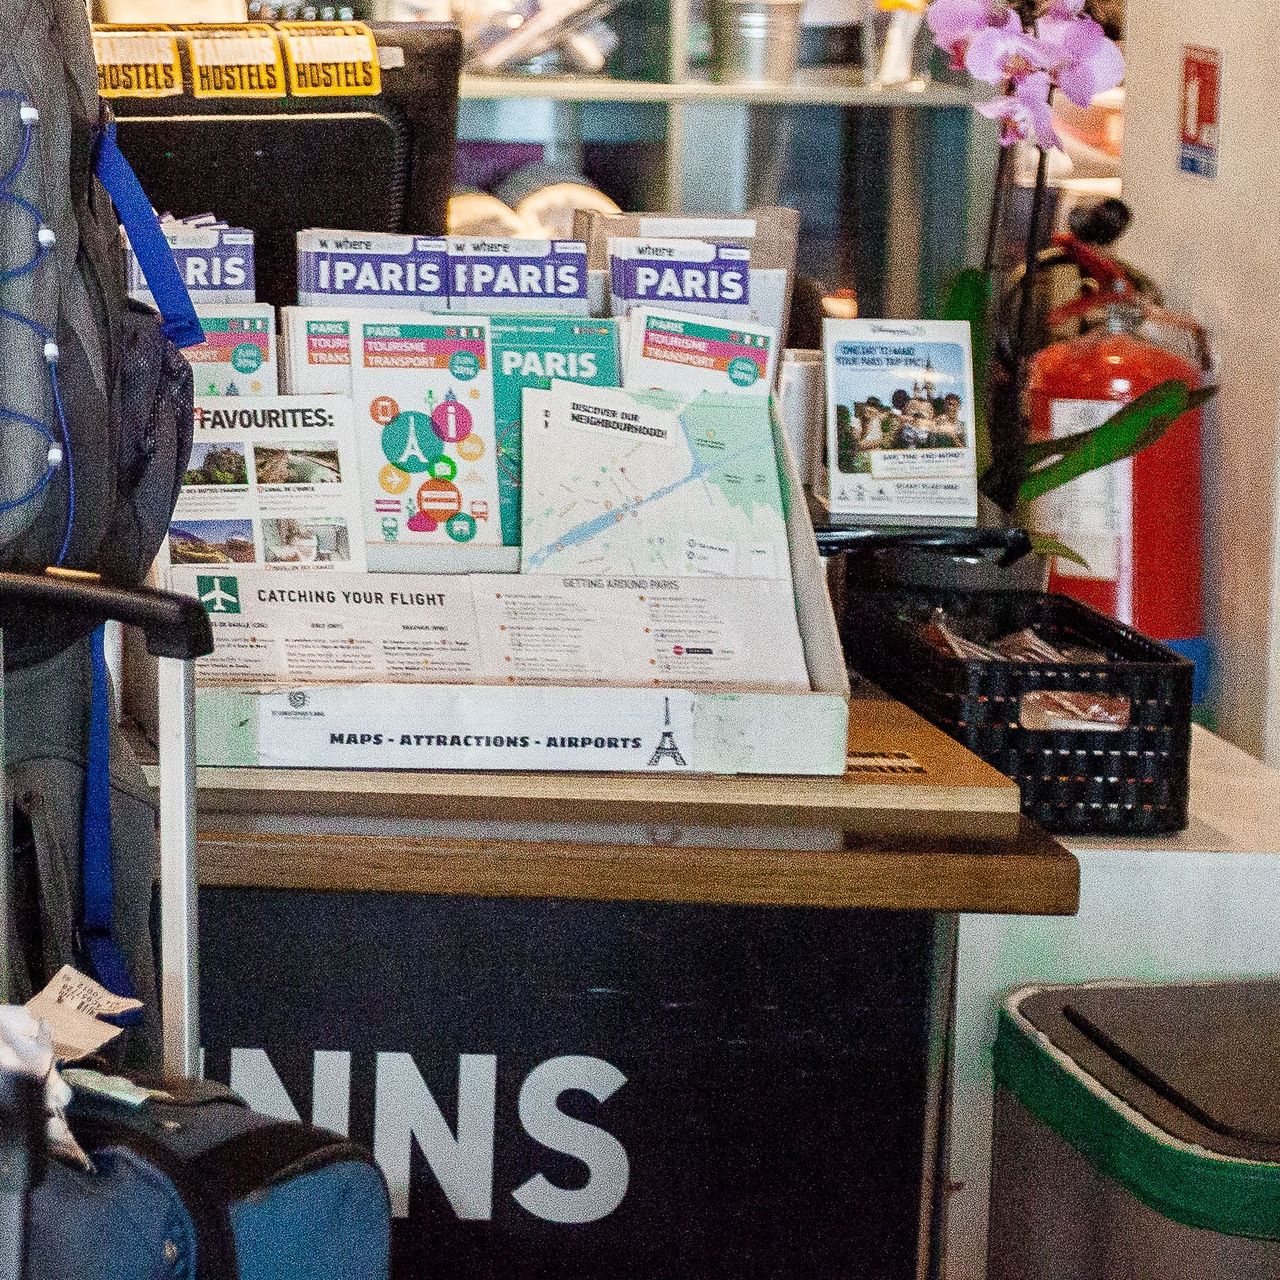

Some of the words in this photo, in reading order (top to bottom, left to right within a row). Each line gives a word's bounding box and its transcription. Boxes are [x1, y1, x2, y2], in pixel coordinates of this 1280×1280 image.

[199, 63, 277, 90] HOSTELS
[296, 61, 373, 88] HOSTELS
[334, 238, 372, 251] where
[472, 240, 510, 253] where
[637, 245, 675, 257] where
[335, 260, 441, 293] PARIS
[474, 262, 579, 294] PARIS
[636, 266, 745, 300] PARIS
[309, 322, 344, 334] PARIS
[367, 326, 400, 338] PARIS
[648, 319, 684, 334] PARIS
[367, 341, 425, 353] TOURISME
[646, 333, 709, 352] TOURISME
[368, 356, 436, 368] TRANSPORT
[502, 351, 598, 379] PARIS
[646, 347, 715, 368] TRANSPORT
[200, 408, 334, 429] FAVOURITES:
[571, 402, 618, 419] DISCOVER
[620, 411, 640, 423] OUR
[571, 413, 668, 439] NEIGHBOURHOOD!
[563, 578, 605, 590] GETTING
[607, 579, 647, 590] AROUND
[257, 589, 336, 603] CATCHING
[342, 591, 384, 605] YOUR
[391, 593, 446, 606] FLIGHT
[329, 732, 384, 746] MAPS
[400, 733, 530, 748] ATTRACTIONS
[546, 735, 642, 749] AIRPORTS
